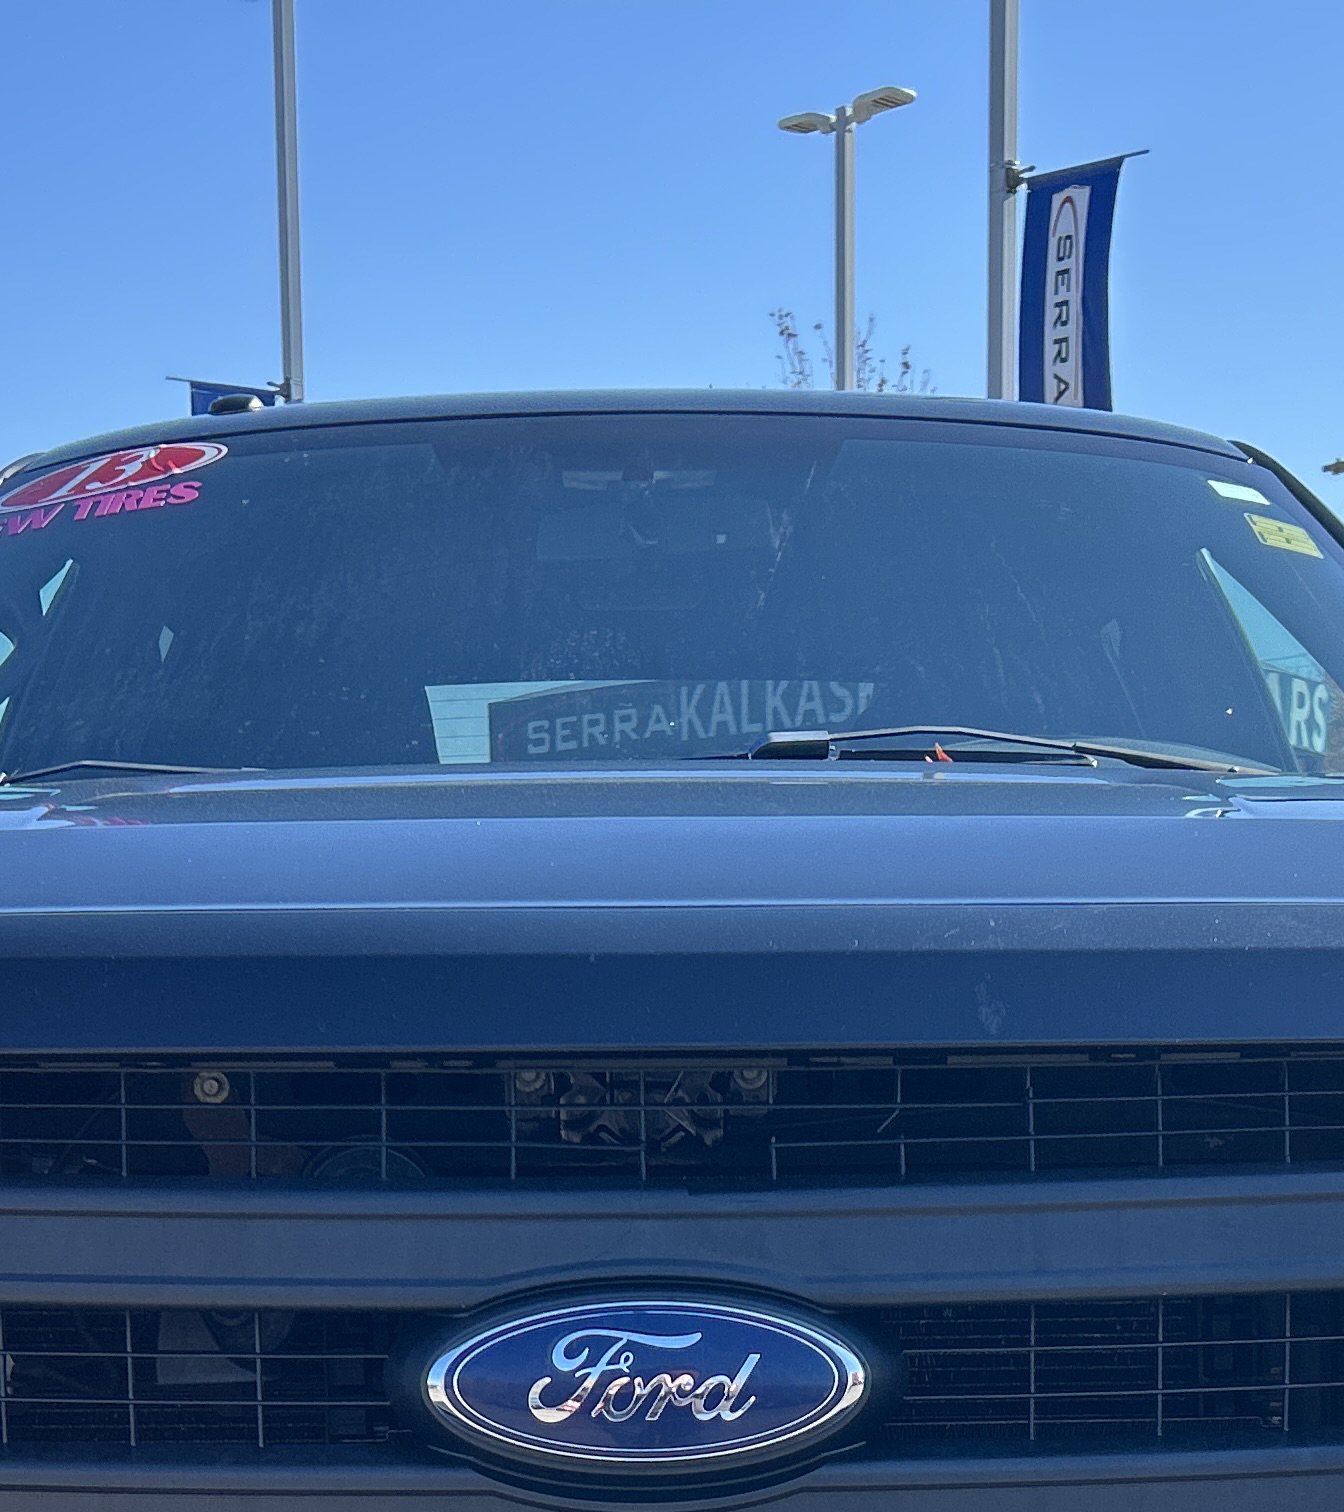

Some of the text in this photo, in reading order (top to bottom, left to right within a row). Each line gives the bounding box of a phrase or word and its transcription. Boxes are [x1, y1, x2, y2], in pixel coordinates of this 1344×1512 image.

[1052, 233, 1073, 404] SERRA
[39, 446, 159, 500] 13
[73, 481, 203, 520] TIRES
[527, 703, 673, 754] SERRA
[529, 1329, 761, 1422] Ford
